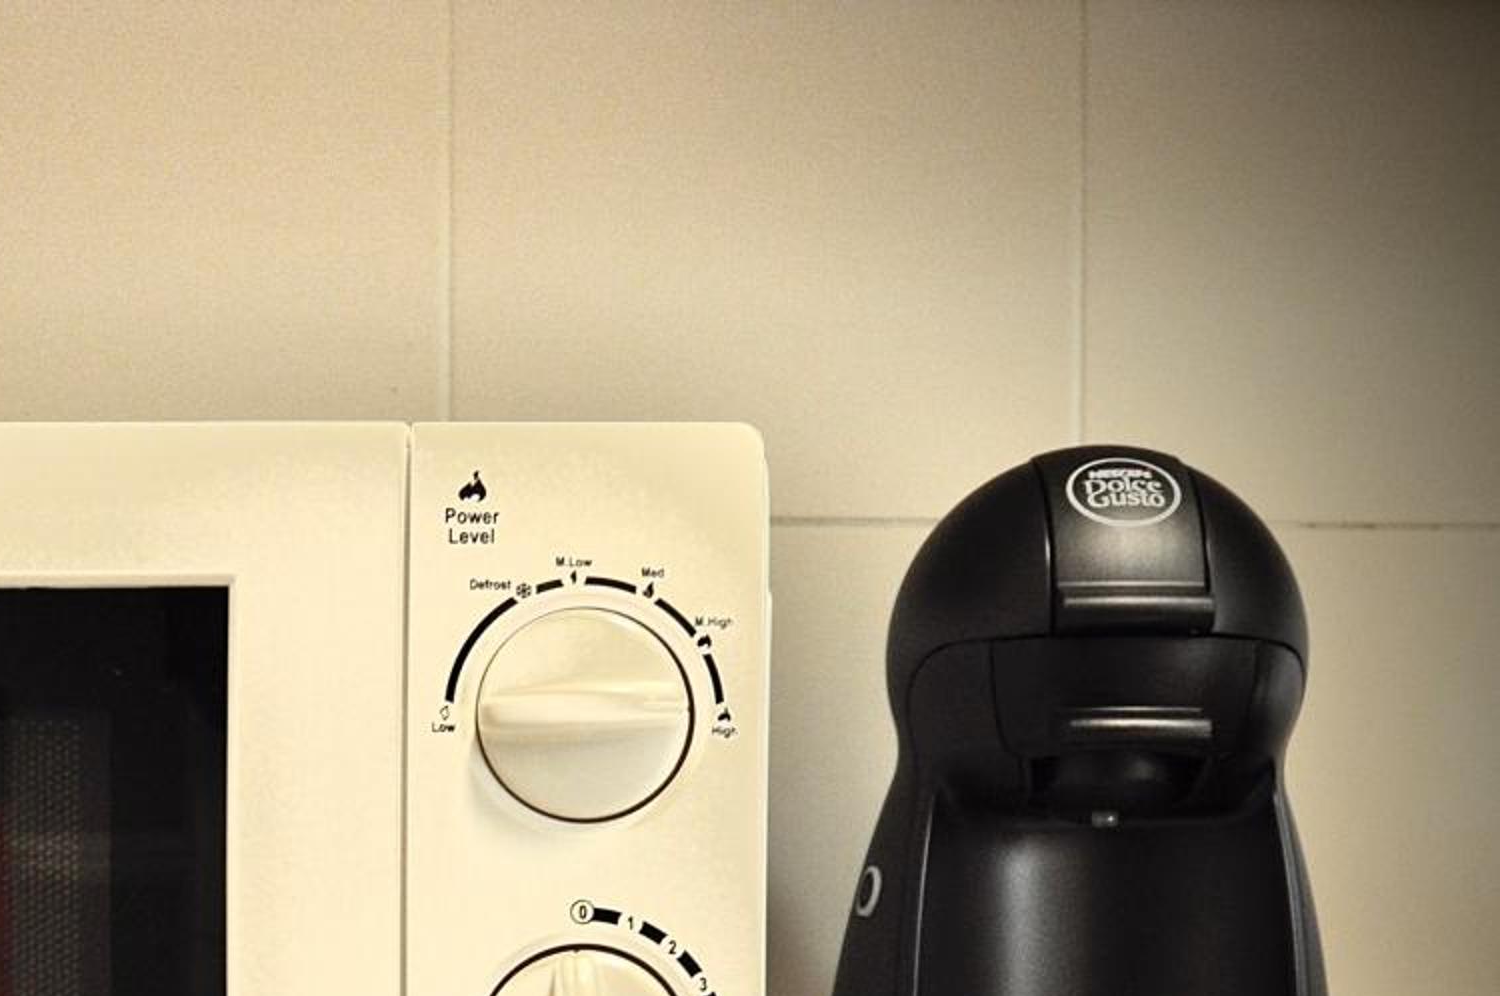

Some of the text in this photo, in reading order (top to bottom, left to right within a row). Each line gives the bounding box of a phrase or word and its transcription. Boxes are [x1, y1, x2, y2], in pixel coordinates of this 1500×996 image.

[1087, 491, 1165, 508] Gusto
[445, 508, 499, 525] Power
[449, 529, 495, 544] Level
[641, 568, 664, 578] Med
[469, 579, 511, 590] Defrost
[432, 723, 455, 733] Low
[712, 726, 738, 738] High
[578, 906, 586, 918] 0
[627, 918, 634, 928] 1
[668, 941, 677, 954] 2
[699, 977, 707, 990] 3
